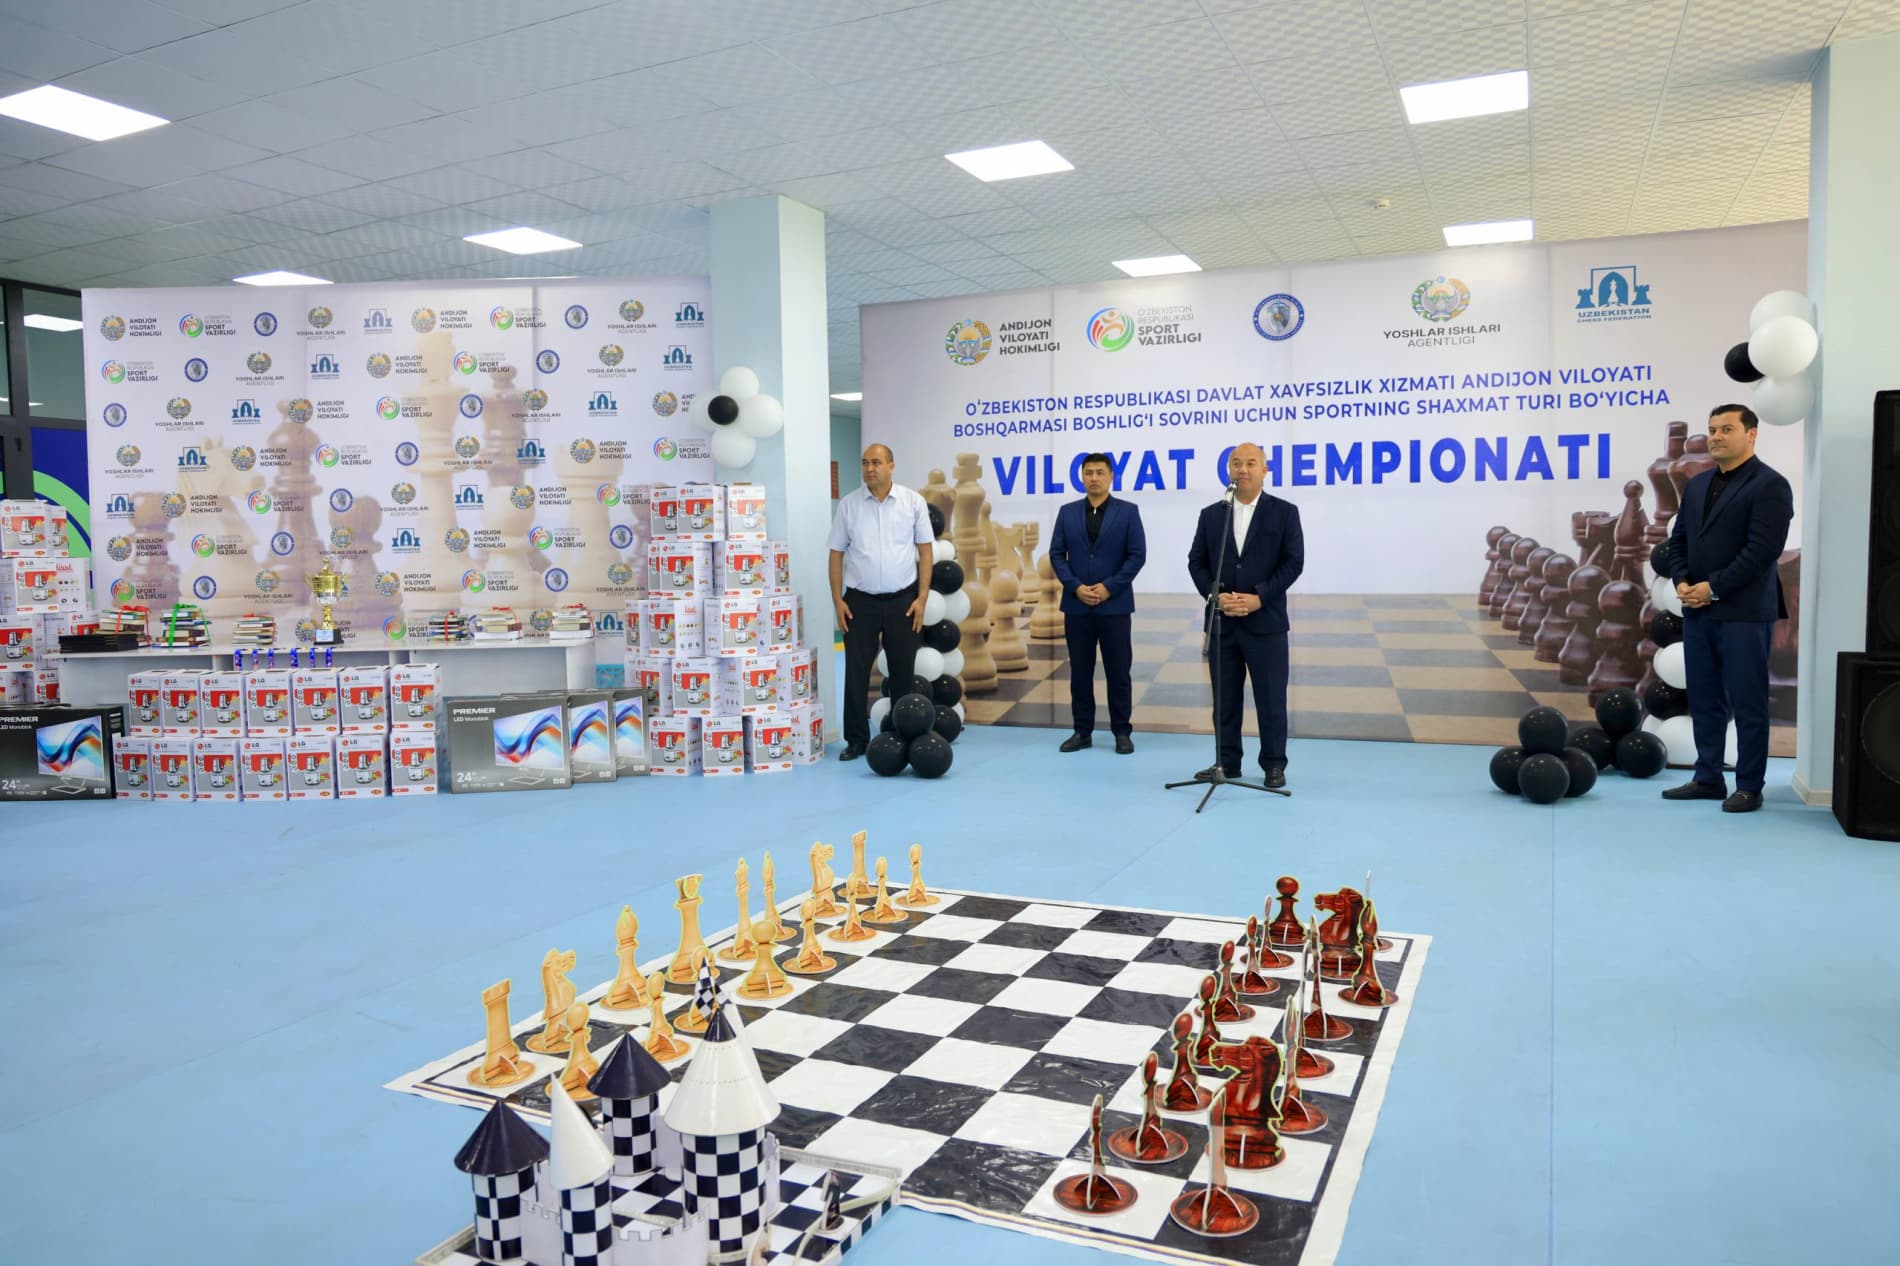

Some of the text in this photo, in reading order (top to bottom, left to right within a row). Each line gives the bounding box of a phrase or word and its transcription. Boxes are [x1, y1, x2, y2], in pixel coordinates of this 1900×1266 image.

[1138, 313, 1194, 324] RESPUBLIKASI
[1578, 308, 1650, 318] UZBEKISTAN
[1000, 319, 1052, 331] ANDIJON
[1138, 324, 1180, 336] SPORT
[1000, 332, 1049, 343] VILOYATI
[1384, 324, 1500, 339] YOSHLAR ISHLARI
[1138, 333, 1201, 346] VAZIRLIGI
[1407, 336, 1475, 348] AGENTLIGI
[1000, 342, 1060, 355] HOKIMLIGI
[1074, 390, 1190, 410] RESPUBLIKASI
[1197, 385, 1264, 403] DAVLAT
[1270, 379, 1373, 399] XAVFSIZLIK
[1379, 375, 1455, 393] XIZMATI
[1461, 370, 1552, 390] ANDIJON
[1559, 365, 1652, 385] VILOYATI
[954, 418, 1067, 437] BOSHQARMASI
[1159, 410, 1228, 426] SOVRINI
[1234, 406, 1297, 423] UCHUN
[1303, 401, 1410, 419] SPORTNING
[1417, 396, 1510, 415] SHAXMAT
[1516, 394, 1561, 410] TURI
